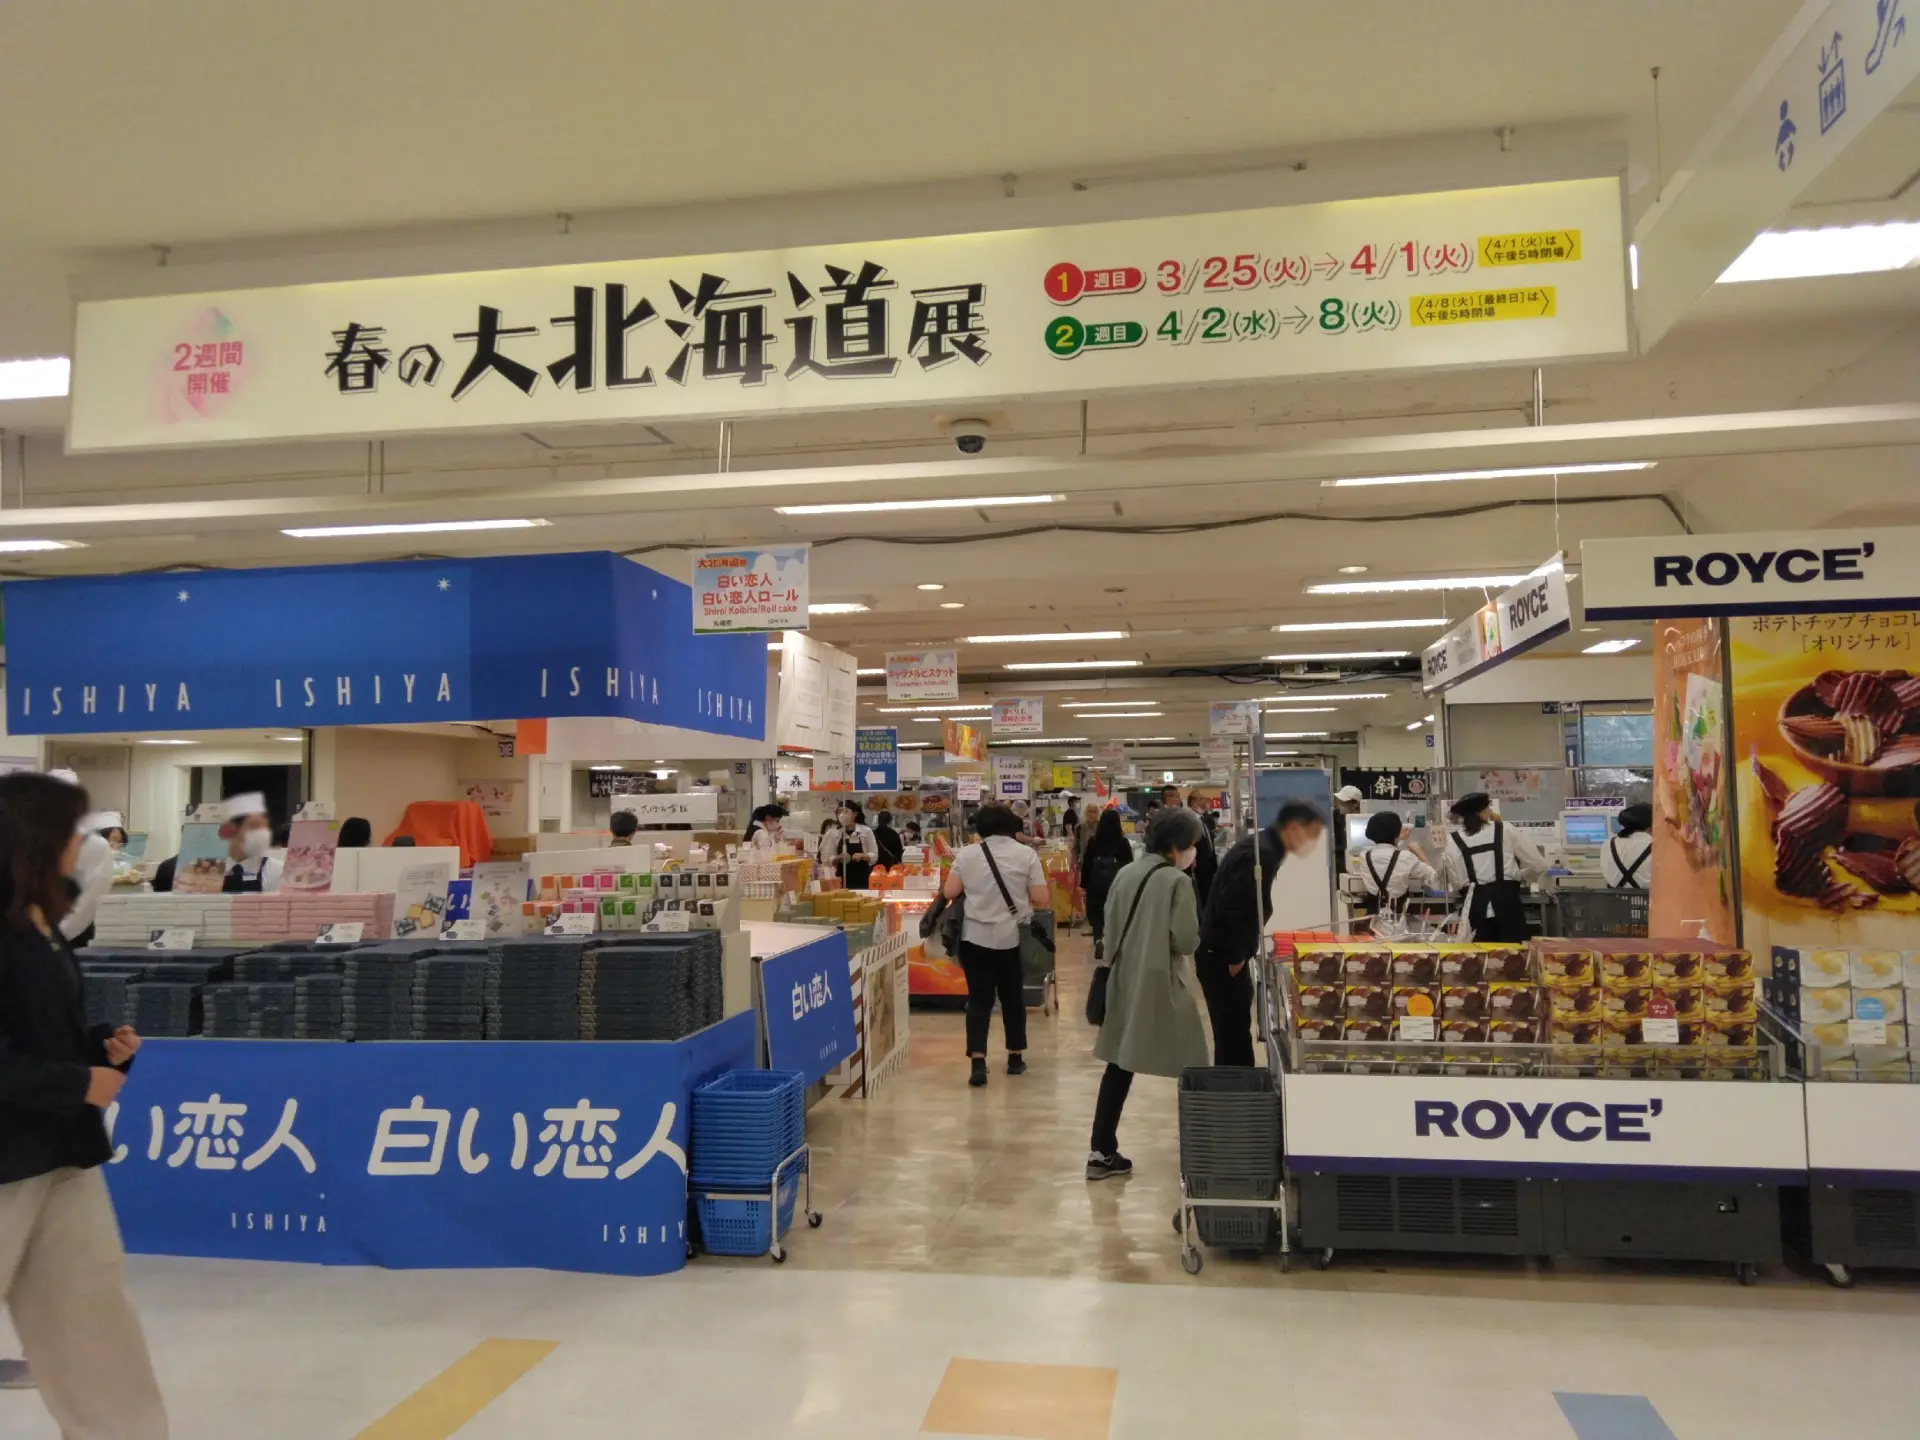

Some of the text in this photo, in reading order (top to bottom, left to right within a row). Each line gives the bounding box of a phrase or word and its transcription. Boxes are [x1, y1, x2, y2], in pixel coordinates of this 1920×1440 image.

[1492, 247, 1566, 262] 午後5時閉場
[1424, 305, 1498, 322] 午後5時閉場
[324, 260, 992, 402] 春の大北海道展
[172, 340, 244, 373] 2週間
[186, 370, 231, 395] 開催
[717, 573, 773, 588] 白い恋人
[702, 589, 800, 606] 白い恋人ロール
[778, 604, 798, 613] cake
[24, 681, 191, 716] ISHIYA
[276, 673, 451, 708] ISHIYA
[541, 666, 660, 705] ISHIYA
[698, 687, 753, 724] ISHIYA
[791, 969, 833, 1021] 白い恋人
[366, 1095, 688, 1180] 白い恋人
[231, 1212, 327, 1233] ISHIYA
